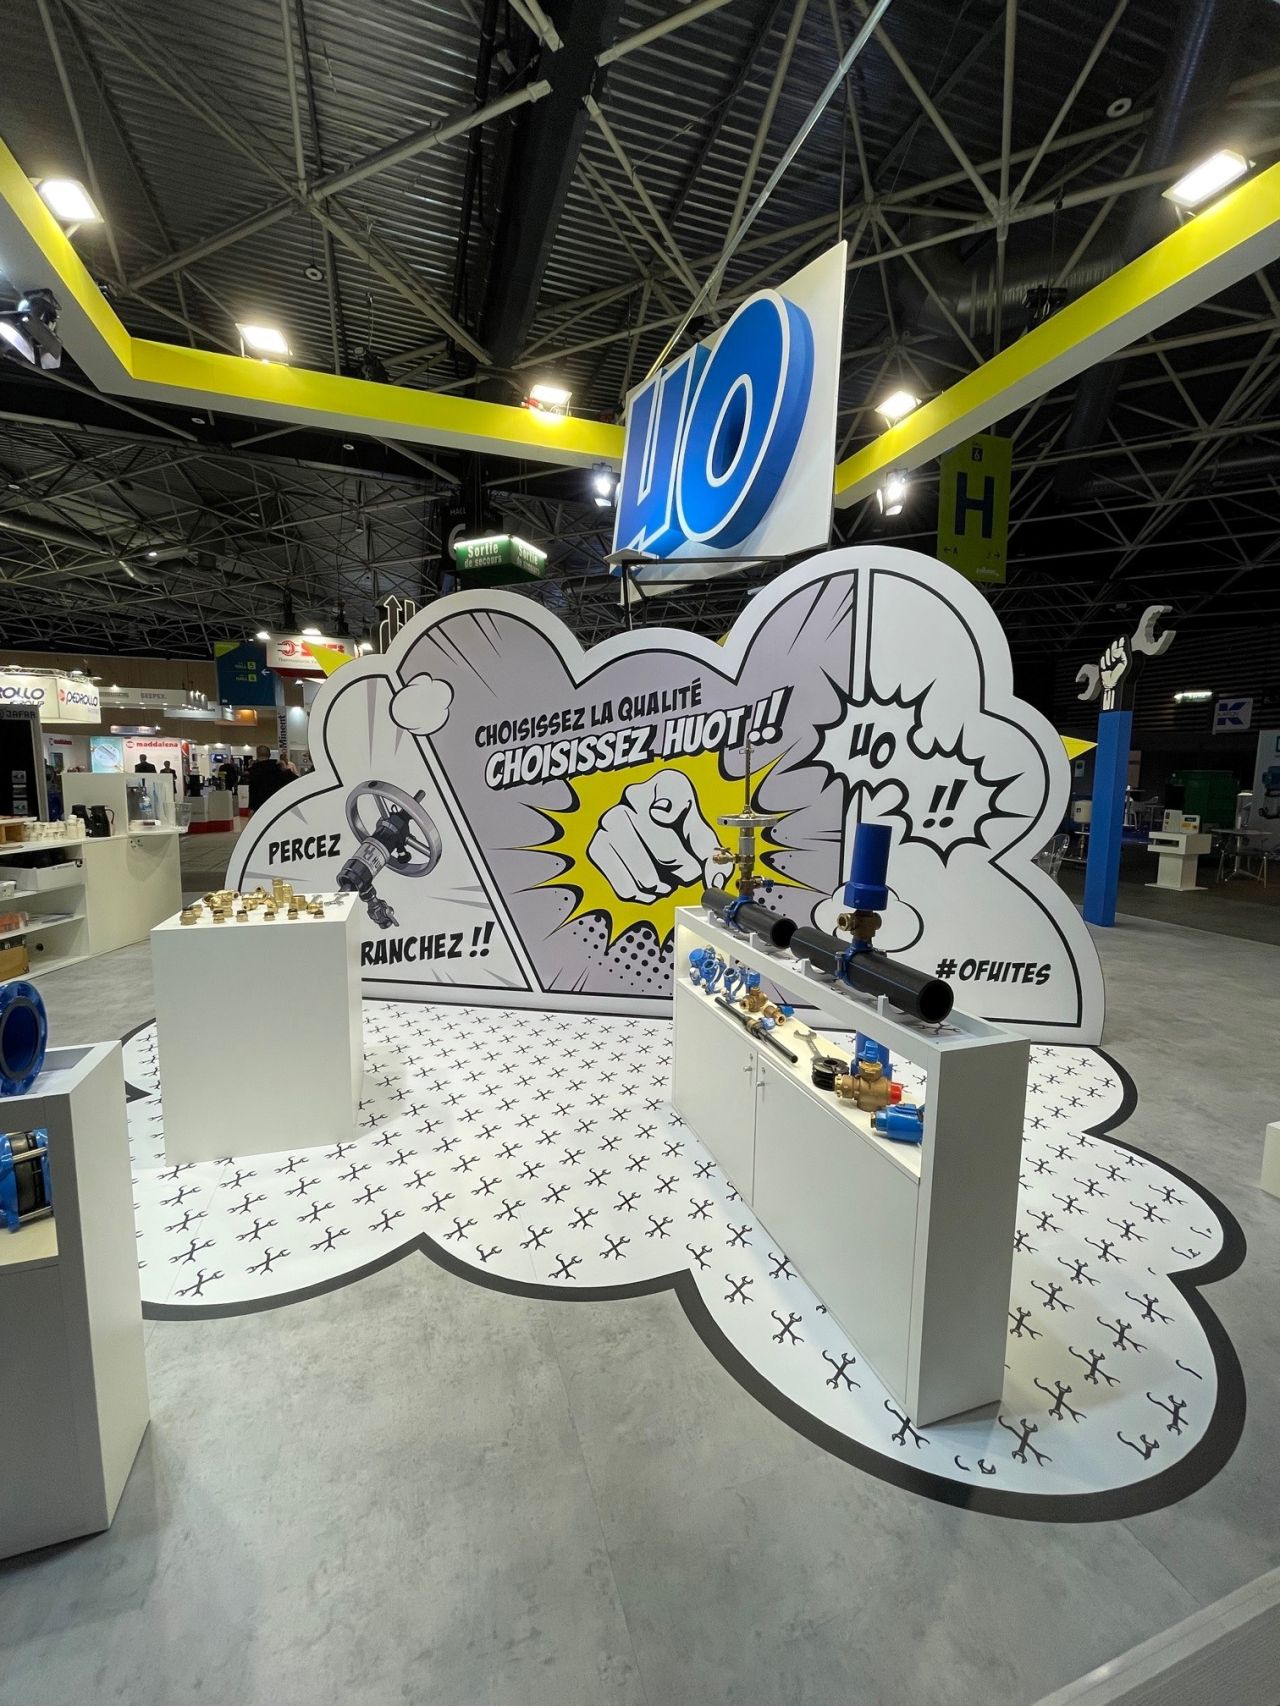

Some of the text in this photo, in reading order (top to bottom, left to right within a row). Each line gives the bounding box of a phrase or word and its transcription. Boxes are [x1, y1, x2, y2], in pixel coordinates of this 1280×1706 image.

[954, 471, 995, 539] H
[464, 555, 502, 568] de secours
[467, 542, 499, 558] Sortie
[518, 545, 538, 565] Sortie
[475, 678, 702, 748] CHOISISSEZ LA QUALITÉ
[484, 726, 656, 791] CHOISISSEZ
[922, 778, 968, 829] !!
[268, 833, 341, 866] PERCEZ
[360, 921, 495, 967] RANCHEZ !!
[935, 958, 1051, 986] #OFUITES
